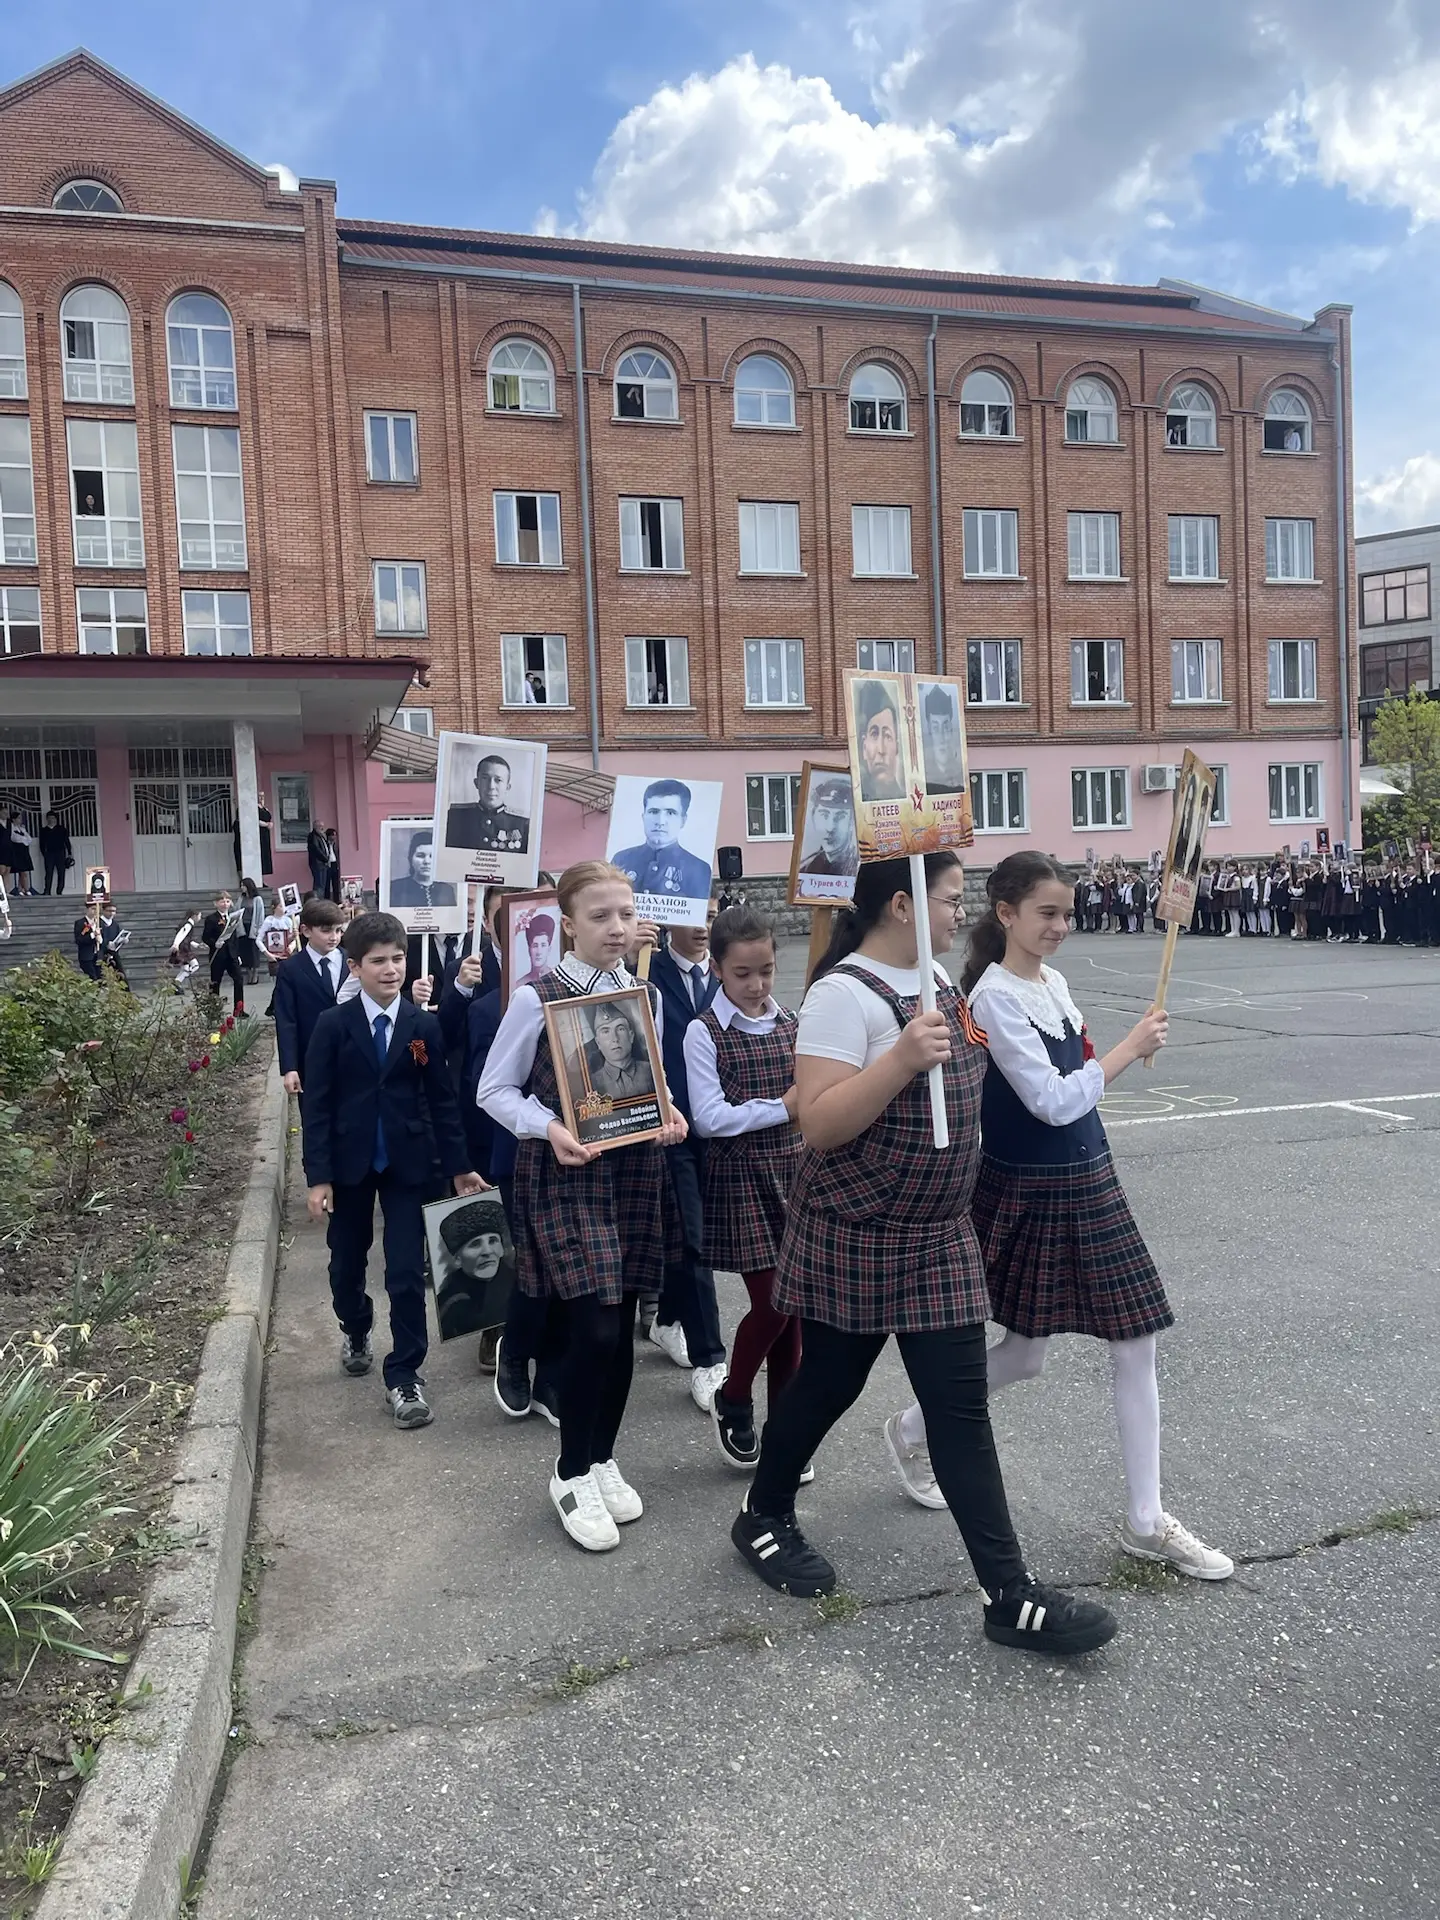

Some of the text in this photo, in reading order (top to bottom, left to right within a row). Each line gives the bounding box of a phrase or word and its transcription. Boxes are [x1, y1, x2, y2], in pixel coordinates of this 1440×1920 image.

[872, 804, 900, 817] ГАТЕЕВ
[932, 799, 961, 811] ХАДИКОВ
[635, 896, 687, 907] ДАХАНОВ
[652, 906, 691, 916] ПЕТРОВИЧ
[620, 1112, 659, 1126] Васильевич
